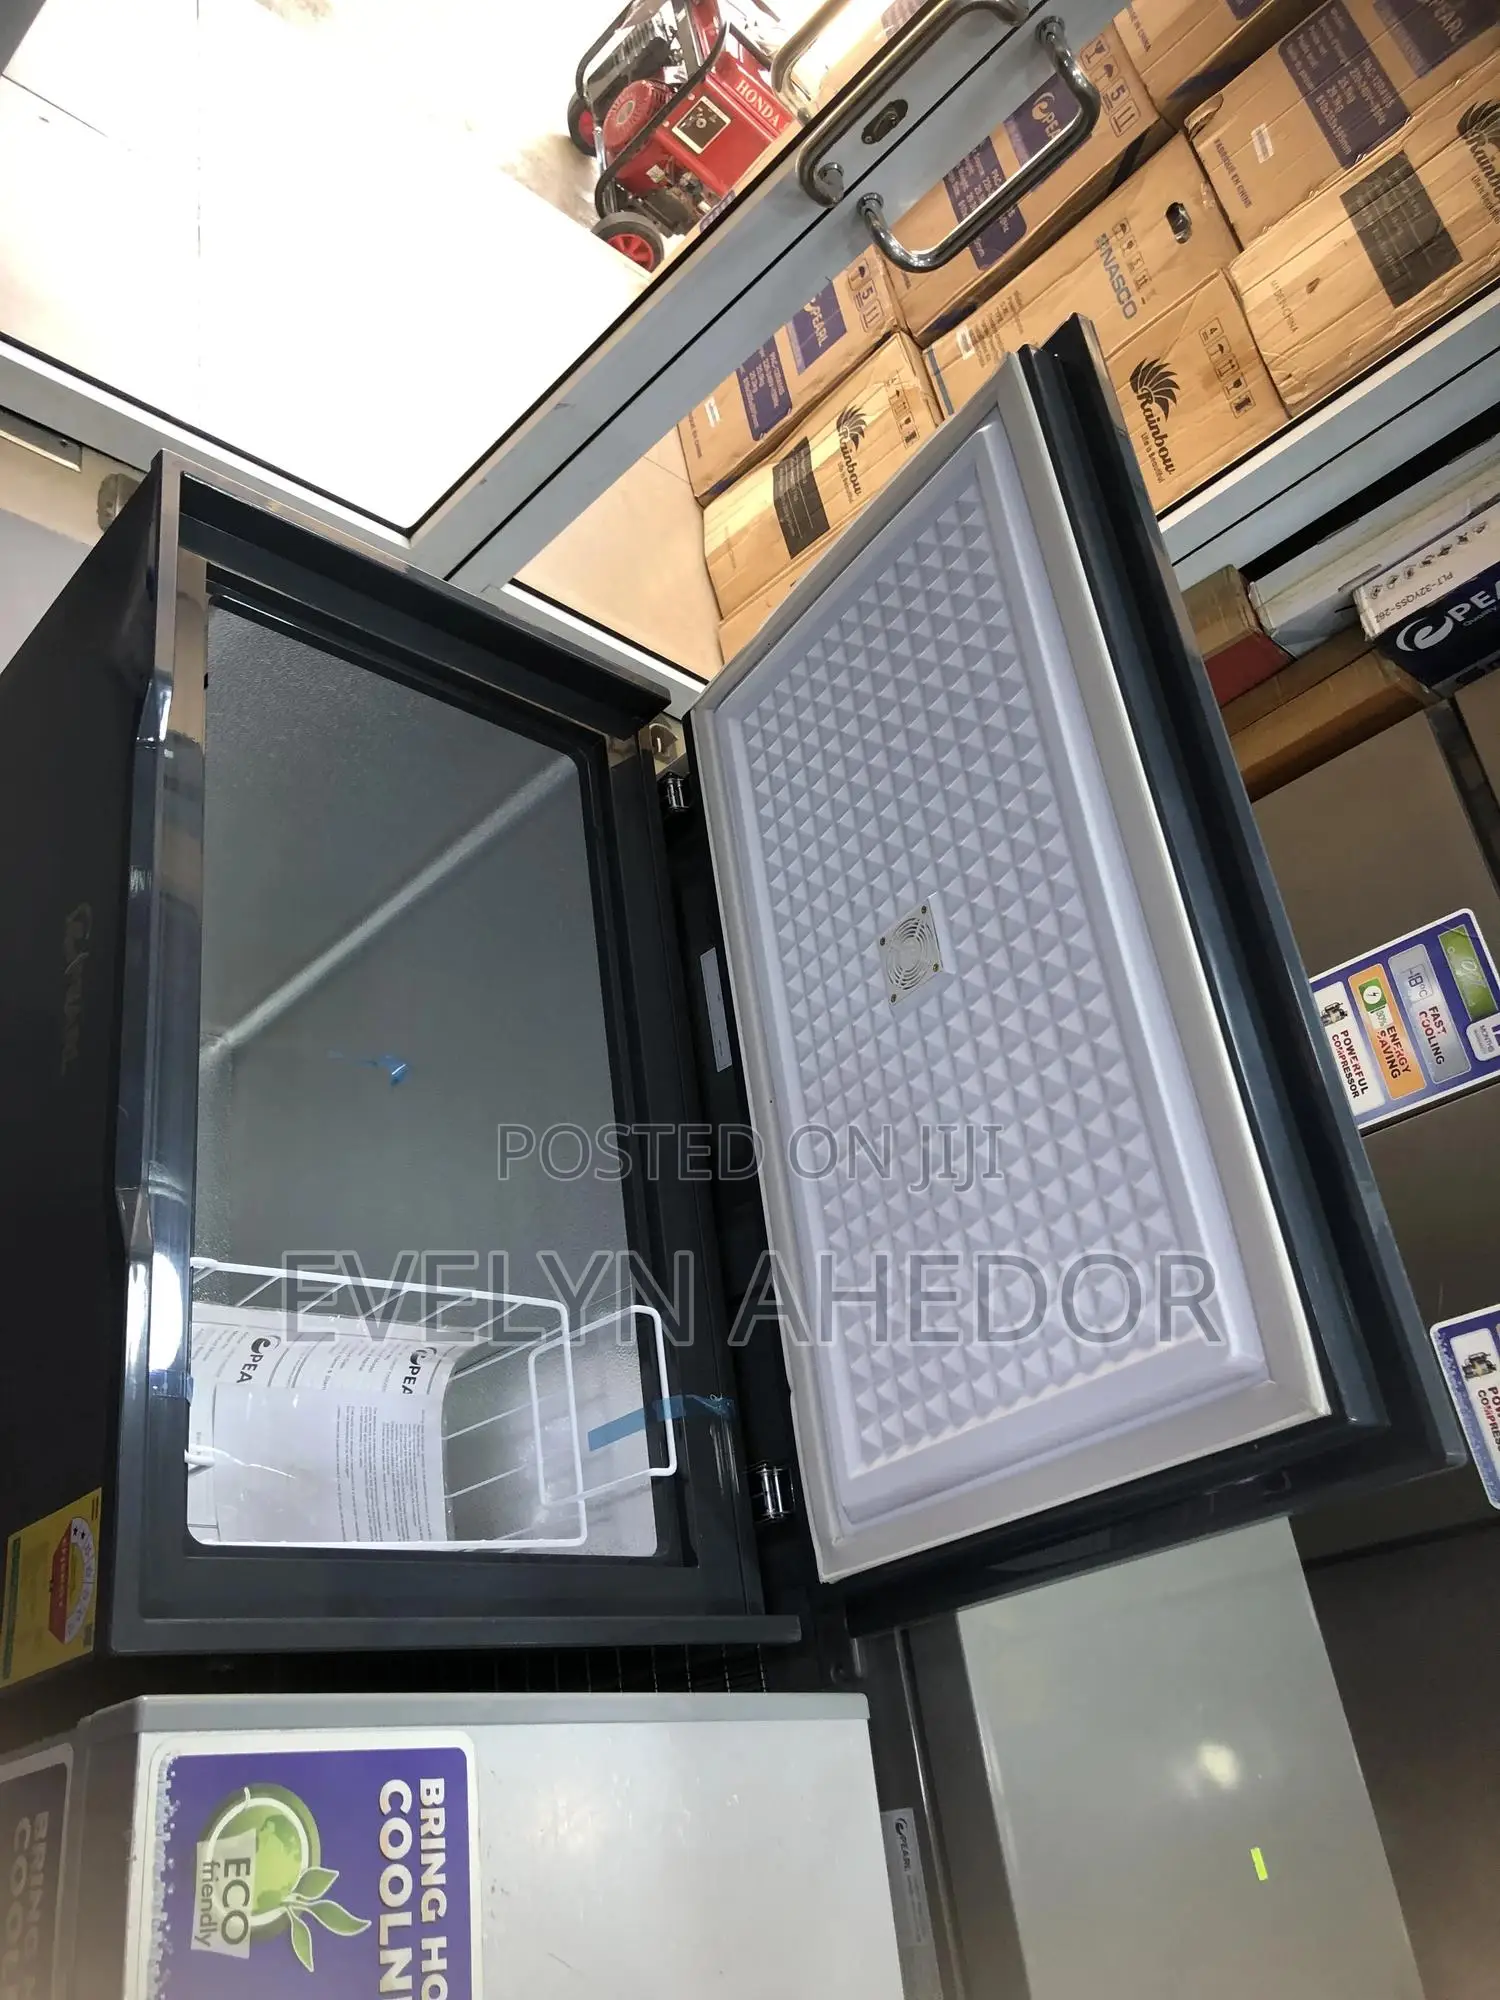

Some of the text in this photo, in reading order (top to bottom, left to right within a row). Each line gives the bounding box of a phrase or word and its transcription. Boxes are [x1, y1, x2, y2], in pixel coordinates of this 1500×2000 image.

[734, 78, 783, 128] HONDA
[1098, 246, 1140, 320] NASCO
[808, 308, 829, 347] PEARL
[838, 428, 862, 494] Rainbow
[1137, 389, 1176, 475] Rainbow
[1447, 578, 1500, 625] PE
[1386, 1026, 1411, 1074] ENERGY
[1419, 1011, 1445, 1065] COOLING
[1428, 1005, 1447, 1035] FAST
[1331, 1034, 1360, 1099] COMPRESSOR
[1340, 1029, 1369, 1095] POWERFUL
[1379, 1030, 1400, 1079] SAVING
[23, 1811, 50, 1958] BRING
[194, 1861, 221, 1948] friendly
[222, 1857, 250, 1945] ECO
[379, 1779, 413, 2000] COOLN
[420, 1778, 448, 2000] BRING HO
